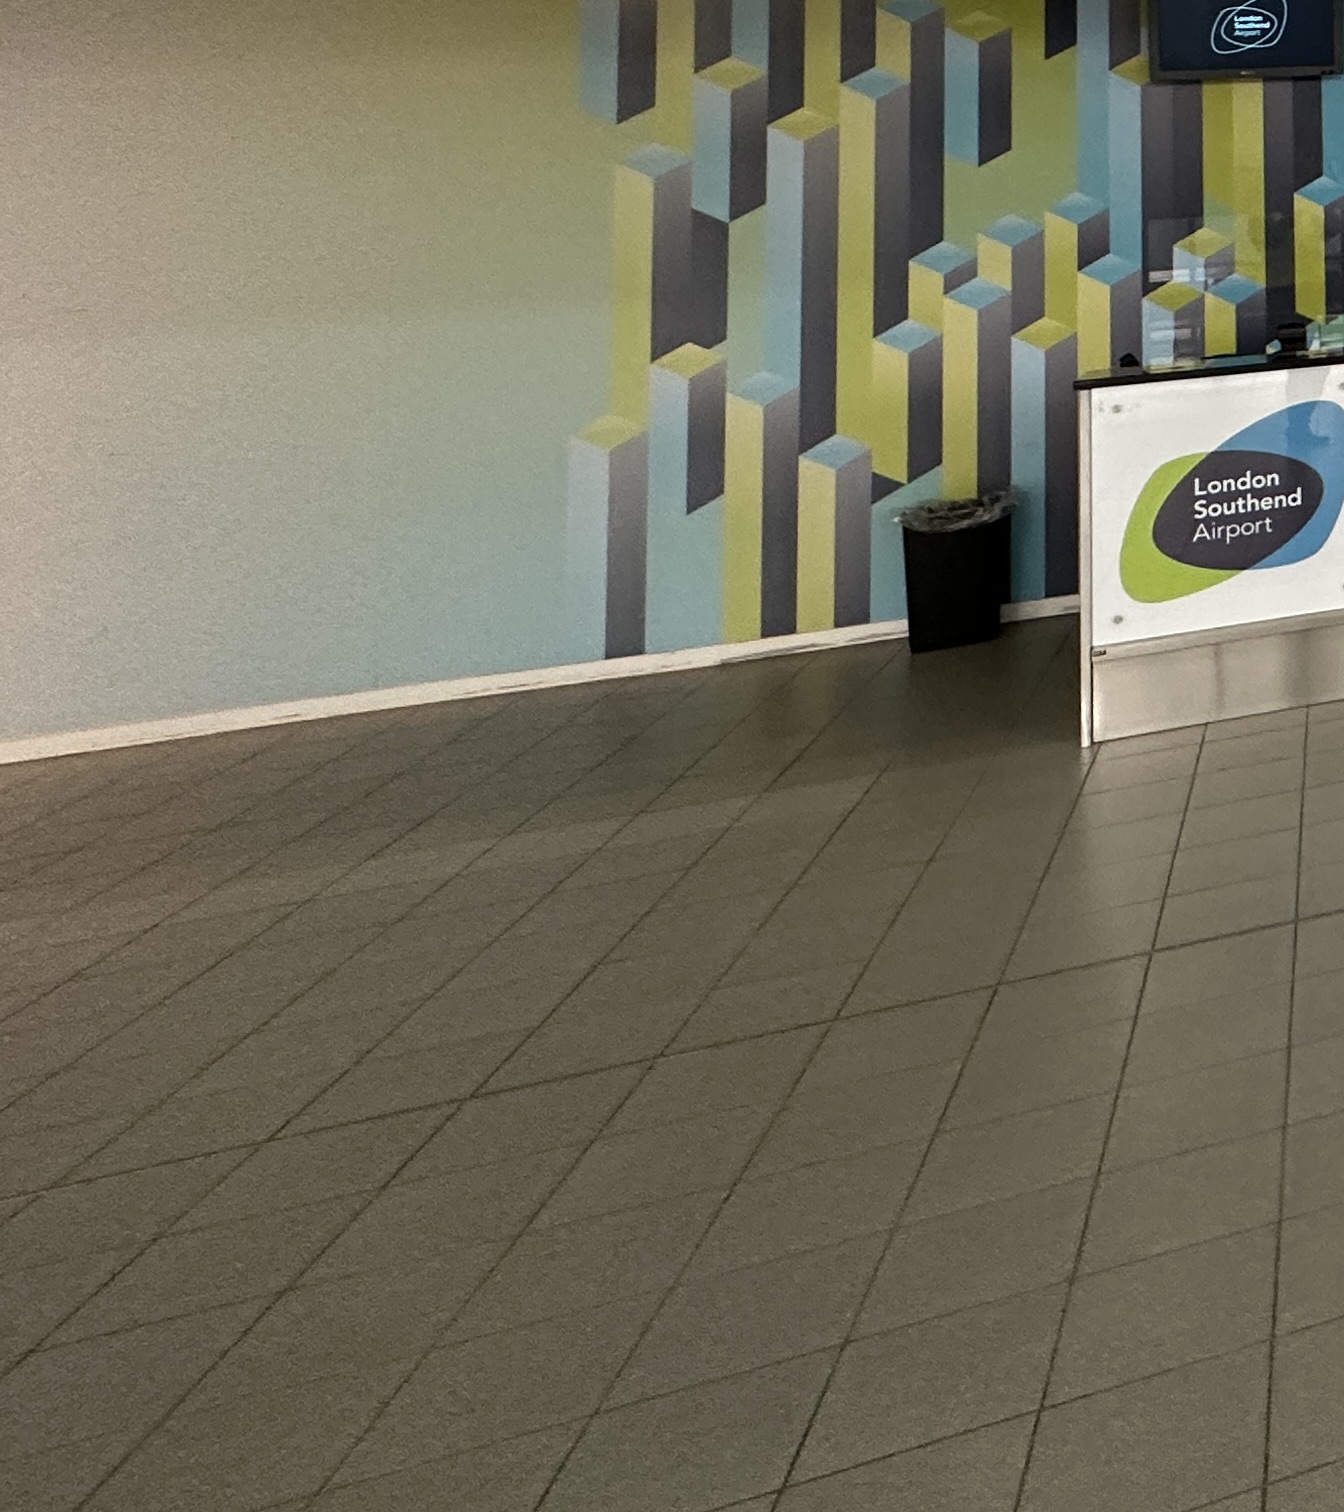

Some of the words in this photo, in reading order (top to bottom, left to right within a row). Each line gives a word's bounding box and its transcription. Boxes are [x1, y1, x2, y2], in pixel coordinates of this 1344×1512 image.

[1194, 470, 1281, 496] London
[1193, 486, 1303, 520] Southend
[1192, 516, 1273, 544] Airport
